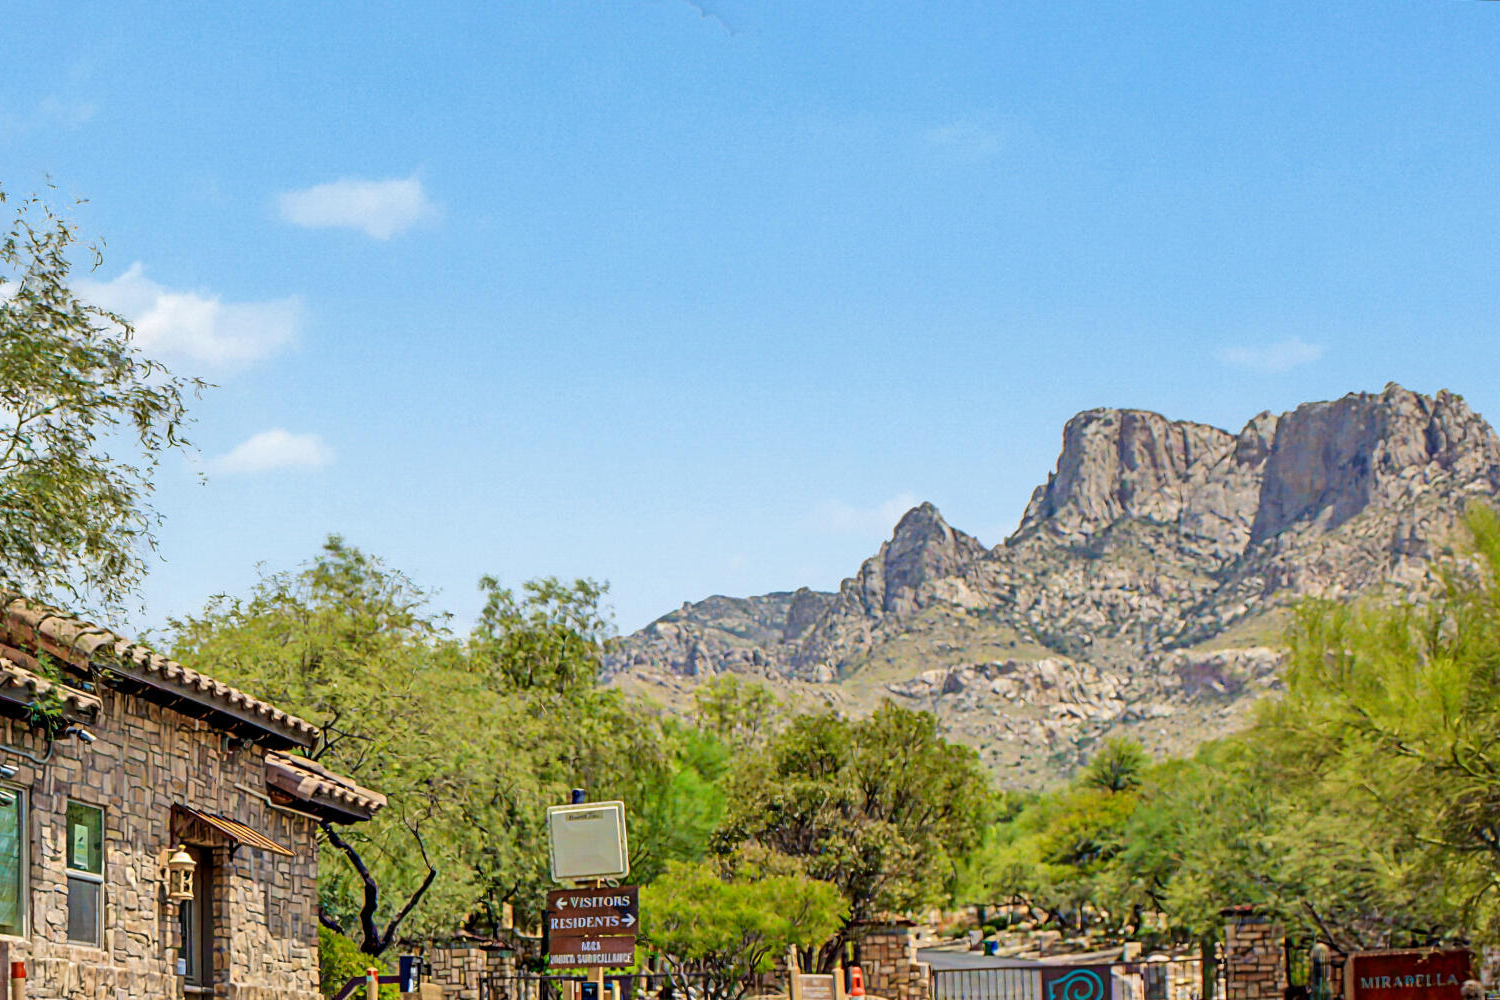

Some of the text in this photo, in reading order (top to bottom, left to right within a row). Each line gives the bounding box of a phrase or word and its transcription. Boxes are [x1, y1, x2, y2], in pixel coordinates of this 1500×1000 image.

[570, 896, 631, 908] VISITORS
[550, 915, 620, 930] RESIDENTS
[1360, 973, 1460, 989] MIRABELLA
